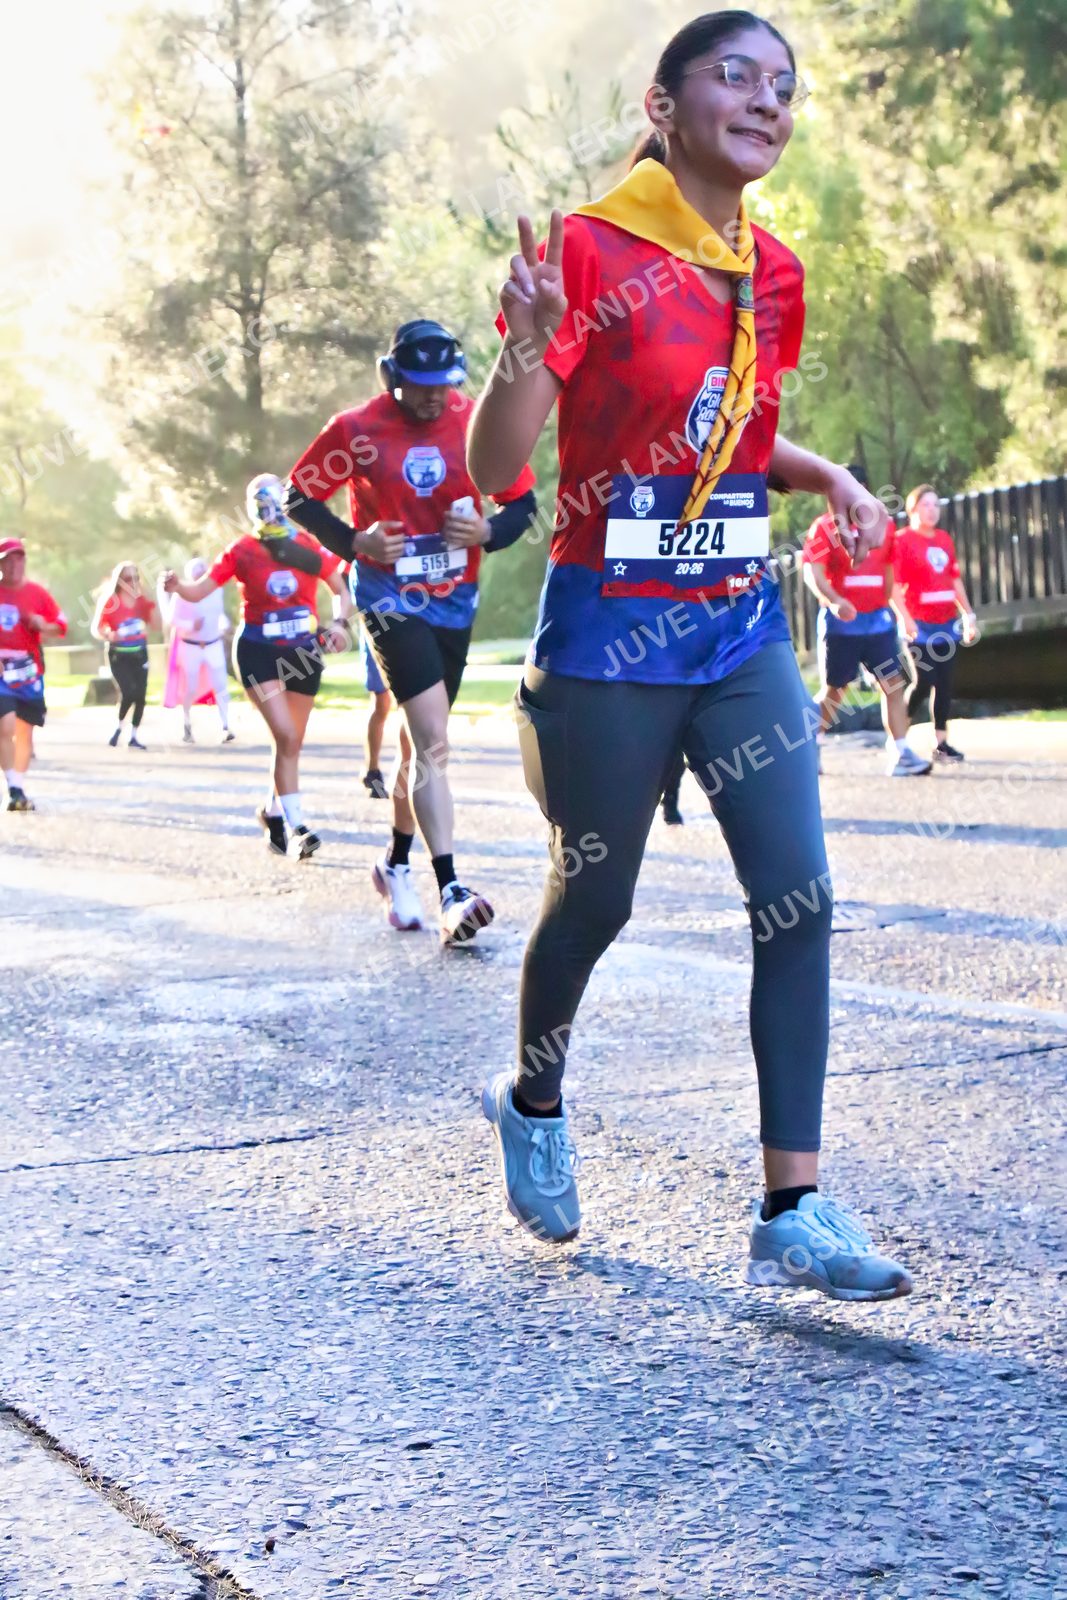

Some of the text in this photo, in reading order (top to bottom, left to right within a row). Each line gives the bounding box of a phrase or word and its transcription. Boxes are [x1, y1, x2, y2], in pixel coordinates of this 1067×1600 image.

[658, 522, 725, 556] 5224
[421, 553, 450, 572] 5159
[729, 577, 751, 588] 10K
